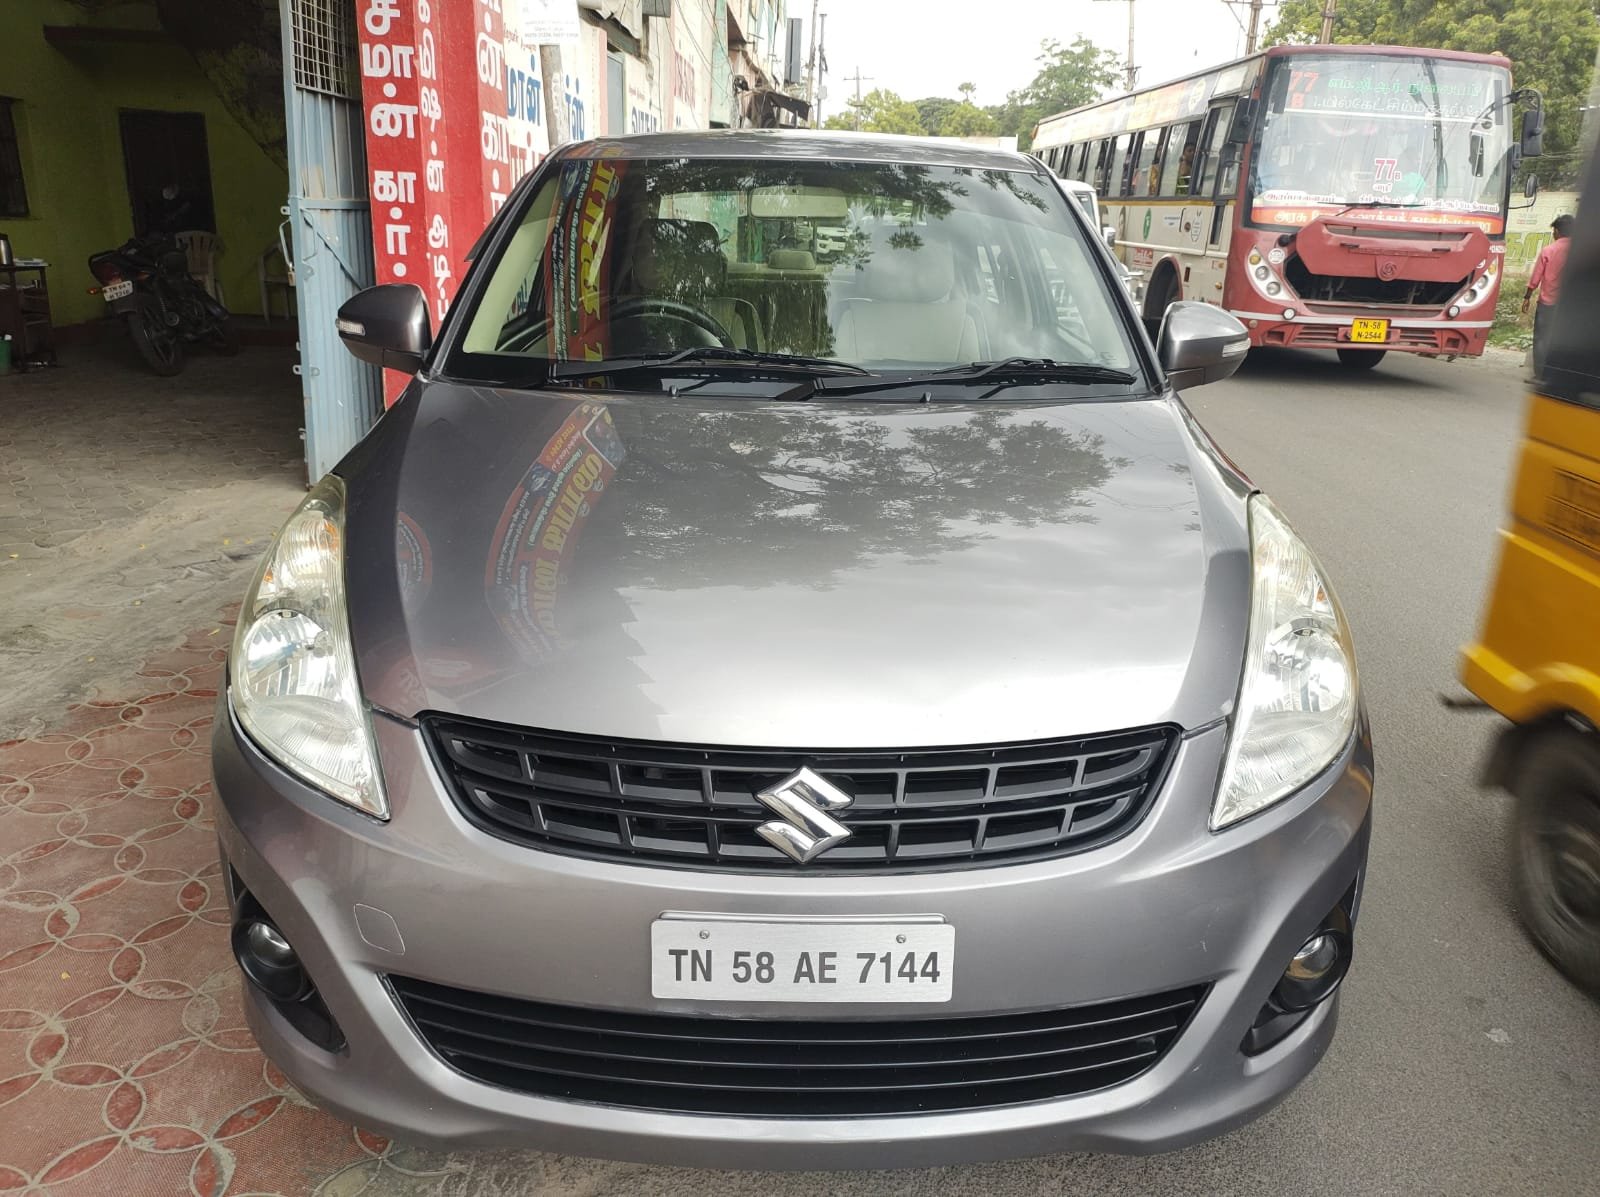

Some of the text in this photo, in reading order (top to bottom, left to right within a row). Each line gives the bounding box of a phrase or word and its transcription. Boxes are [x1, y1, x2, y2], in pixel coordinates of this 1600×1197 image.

[669, 949, 940, 984] TN 58 AE 7144
